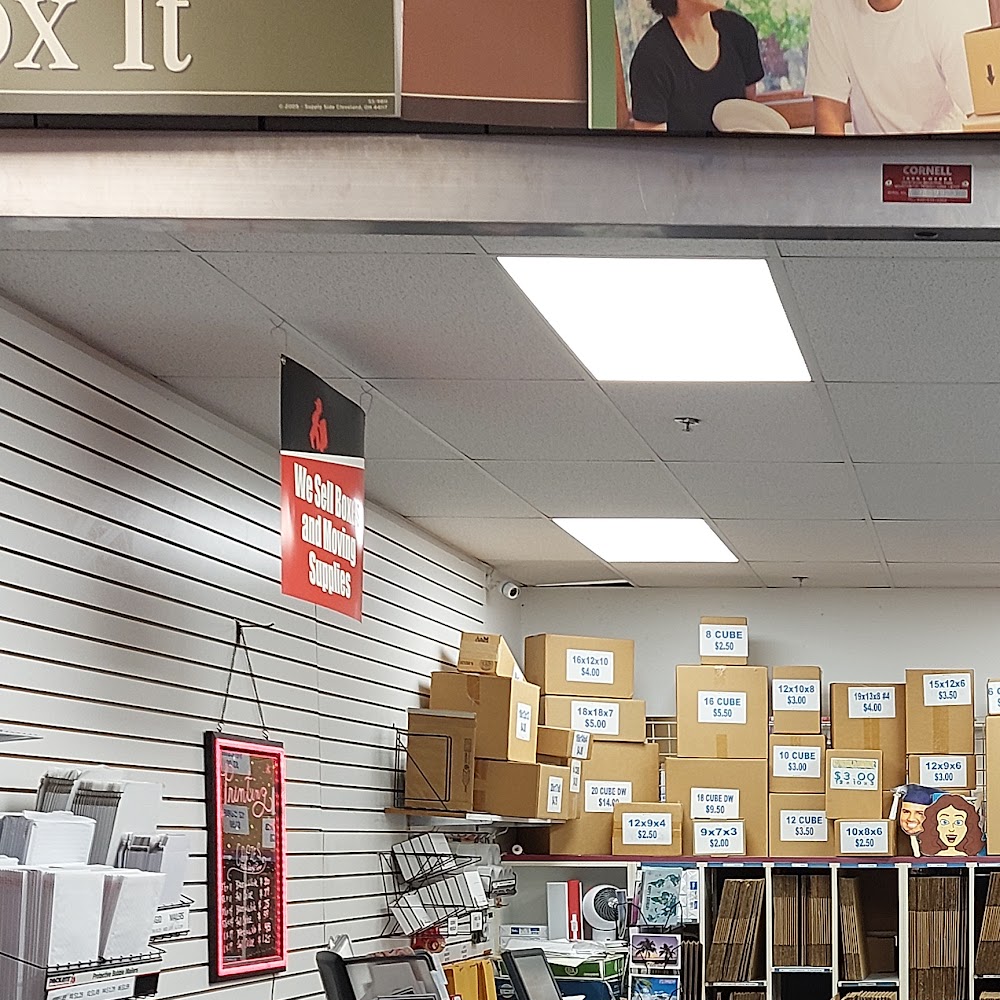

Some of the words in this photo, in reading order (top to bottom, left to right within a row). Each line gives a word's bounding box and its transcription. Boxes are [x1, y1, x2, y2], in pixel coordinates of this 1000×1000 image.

[0, 0, 80, 71] x
[113, 0, 194, 73] It
[902, 166, 952, 176] CORNELL
[292, 462, 314, 504] We
[314, 473, 335, 514] Sell
[301, 513, 321, 546] and
[322, 518, 356, 568] Moving
[308, 550, 352, 600] Supplies
[706, 630, 712, 640] 8
[714, 630, 743, 640] CUBE
[714, 642, 734, 651] $2.50
[572, 656, 609, 666] 16x12x10
[581, 667, 600, 678] $4.00
[778, 684, 815, 693] 12x10x8
[929, 680, 966, 689] 15x12x6
[716, 698, 741, 706] CUBE
[787, 695, 806, 706] $3.00
[863, 702, 882, 712] $4.00
[713, 708, 732, 718] $5.50
[584, 718, 606, 730] $5.00
[780, 752, 790, 760] 10
[792, 752, 816, 760] CUBE
[788, 762, 807, 772] $3.00
[926, 761, 962, 770] 12x9x6
[834, 771, 876, 782] $3.00
[934, 772, 954, 782] $3.00
[591, 786, 599, 796] 20
[600, 786, 616, 796] CUBE
[617, 786, 627, 796] DW
[706, 794, 722, 803] CUBE
[706, 804, 725, 814] $9.50
[628, 819, 666, 828] 12x9x4
[786, 816, 796, 824] 12
[798, 816, 823, 824] CUBE
[638, 829, 658, 840] $2.50
[700, 828, 738, 836] 9x7x3
[795, 826, 814, 836] $3.50
[846, 828, 883, 836] 10x8x6
[710, 838, 729, 848] $2.00
[855, 838, 874, 848] $2.50
